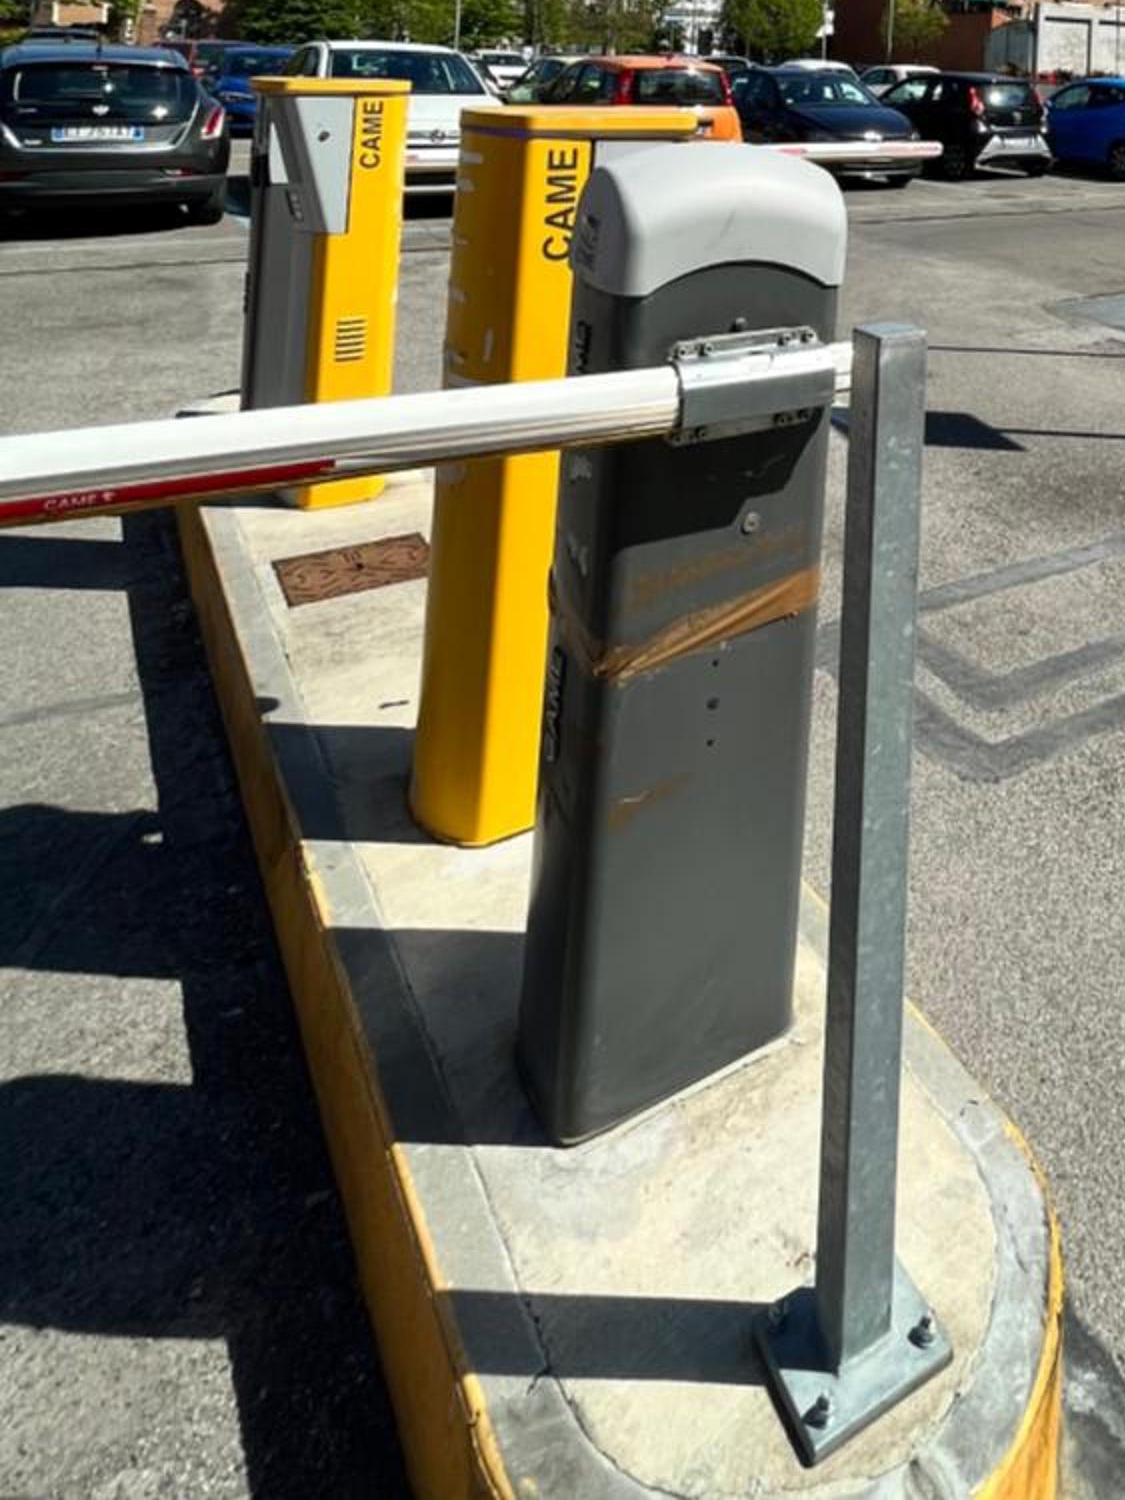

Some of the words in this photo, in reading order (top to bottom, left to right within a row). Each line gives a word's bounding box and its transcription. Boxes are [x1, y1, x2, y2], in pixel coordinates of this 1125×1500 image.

[359, 100, 384, 169] CAME
[542, 147, 579, 260] CAME
[43, 491, 97, 511] CAME
